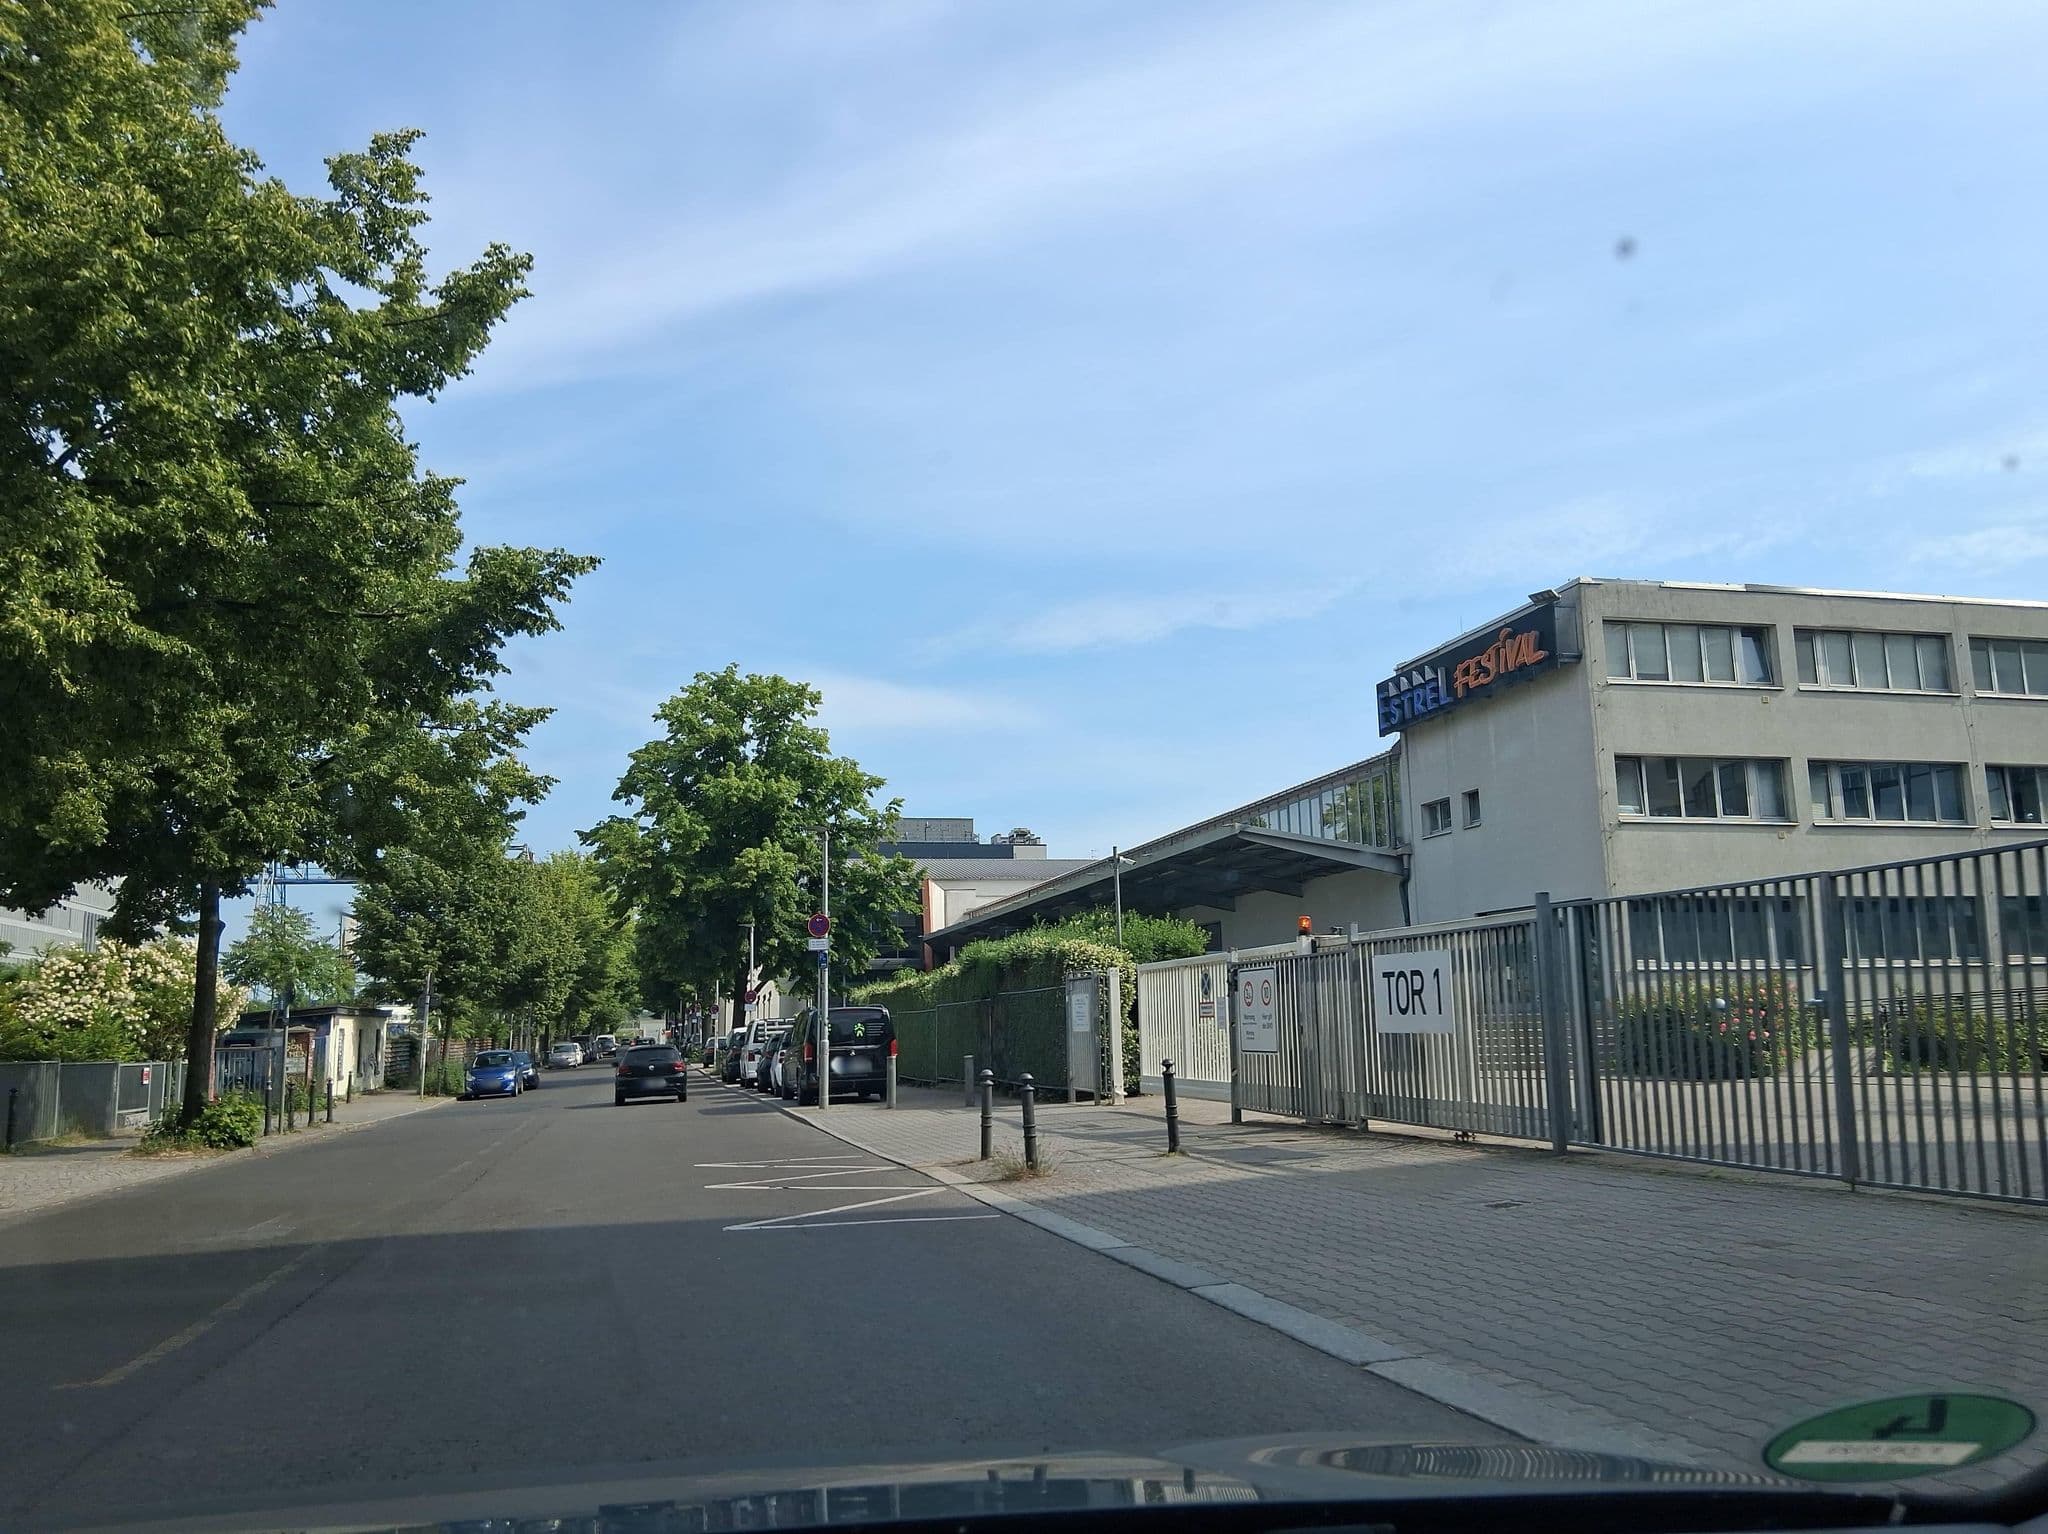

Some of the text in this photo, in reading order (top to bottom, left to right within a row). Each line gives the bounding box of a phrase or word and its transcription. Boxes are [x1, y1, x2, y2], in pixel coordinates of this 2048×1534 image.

[1379, 667, 1453, 730] ESTREL
[1382, 968, 1442, 1015] TOR 1
